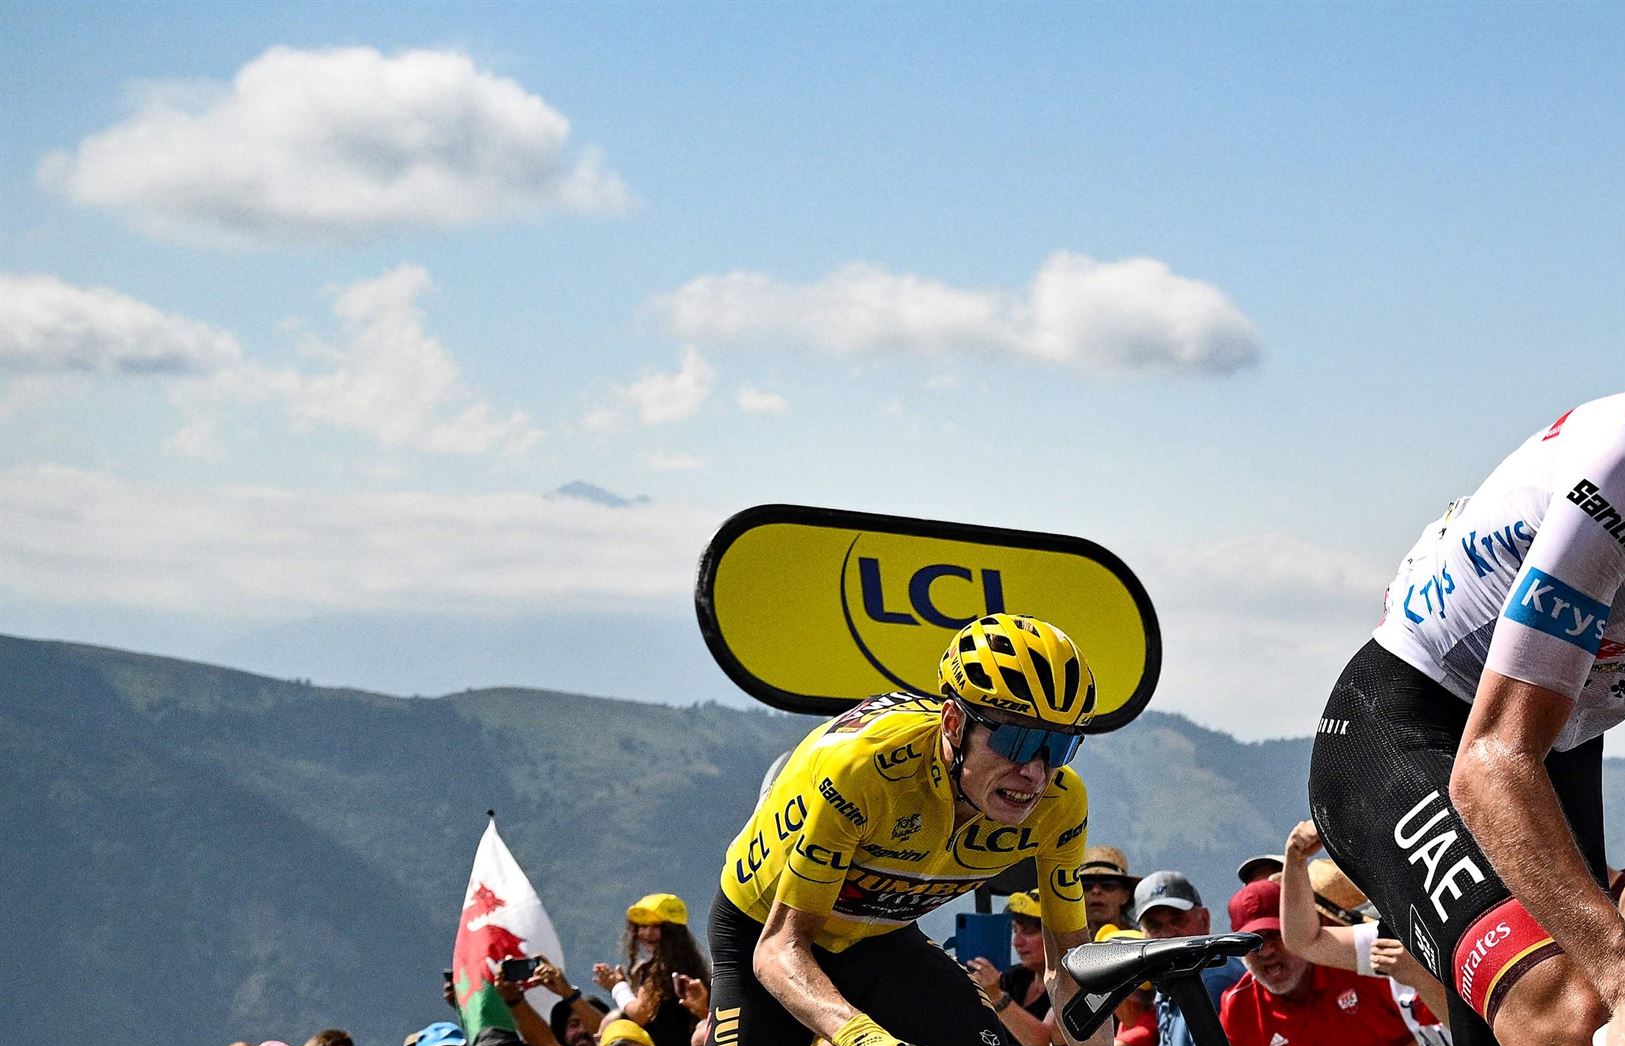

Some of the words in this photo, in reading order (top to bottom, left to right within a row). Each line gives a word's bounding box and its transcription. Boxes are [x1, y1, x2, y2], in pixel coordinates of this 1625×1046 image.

[1462, 520, 1534, 578] Krys
[1521, 578, 1606, 639] Krys
[951, 656, 966, 690] VISMA
[980, 695, 1030, 713] LAZER
[877, 744, 923, 769] LCL
[795, 835, 850, 870] LCL
[963, 823, 1040, 852] LCL
[736, 830, 770, 884] LCL
[1394, 790, 1485, 923] UAE
